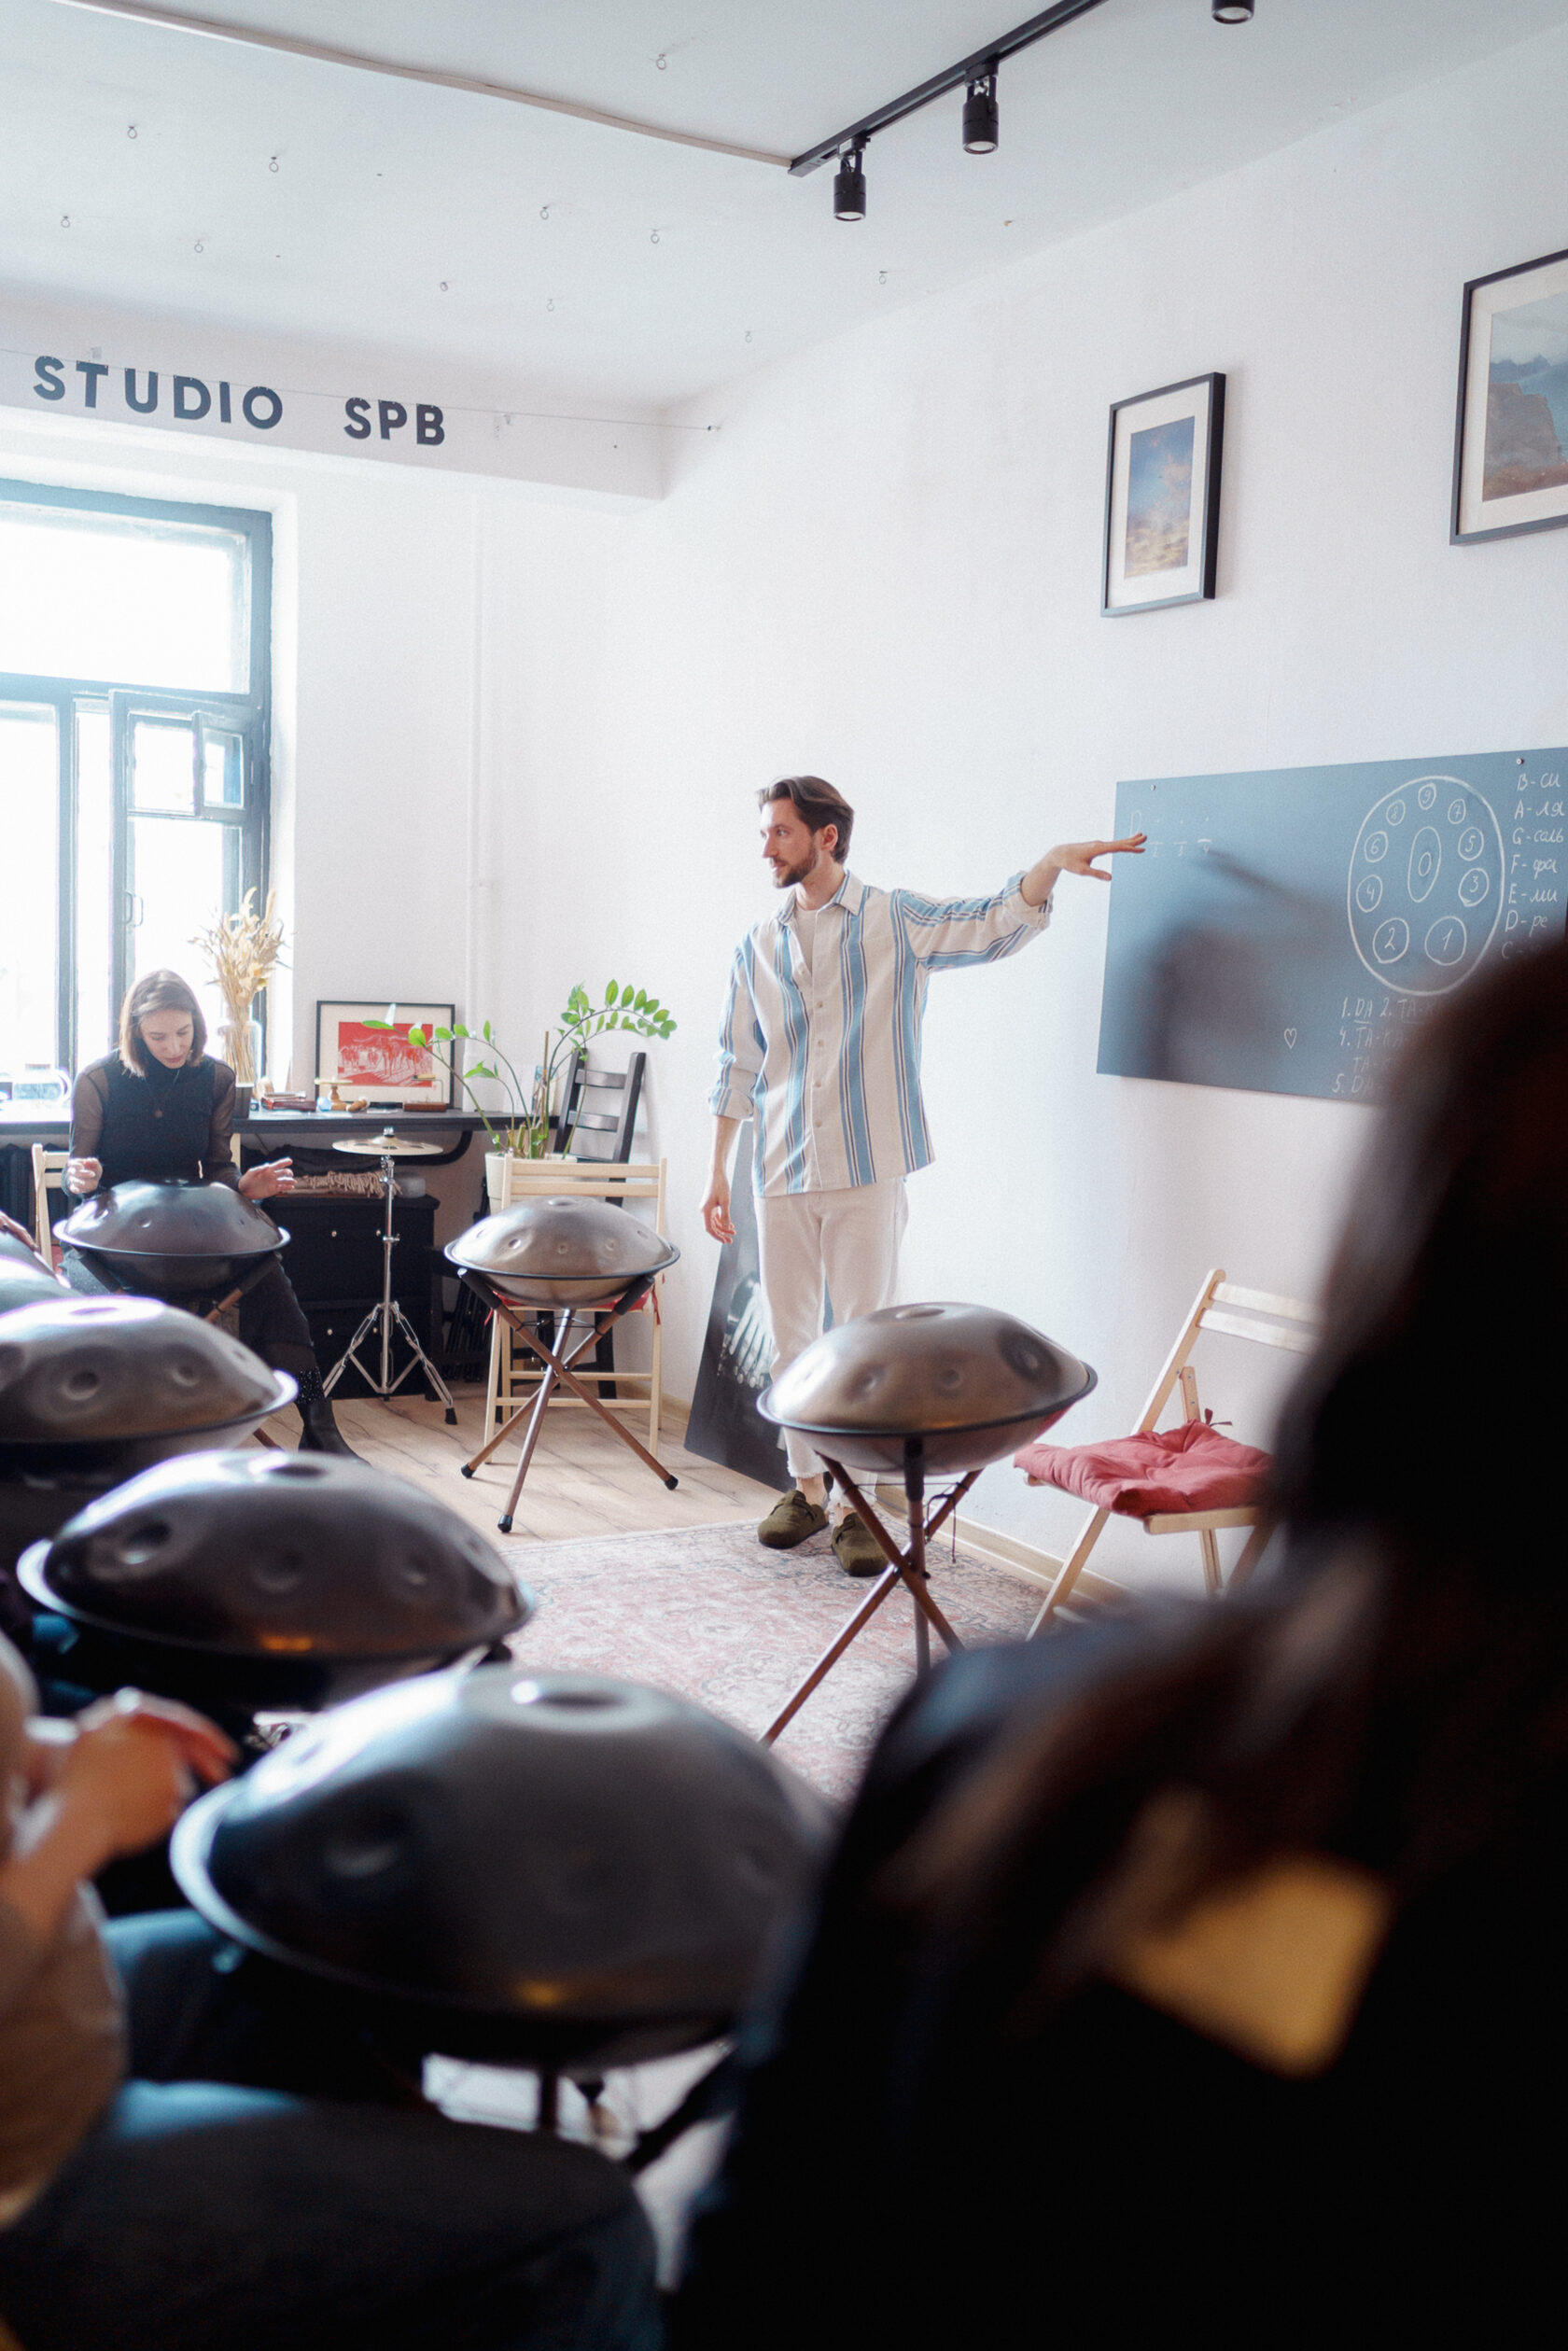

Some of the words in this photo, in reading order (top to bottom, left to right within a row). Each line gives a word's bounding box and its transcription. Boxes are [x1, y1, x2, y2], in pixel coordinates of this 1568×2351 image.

[33, 356, 283, 429] STUDIO
[343, 397, 446, 446] SPB
[1464, 834, 1476, 853] 5
[1365, 883, 1376, 902] 4
[1469, 875, 1479, 893] 3
[1384, 926, 1397, 951] 2
[1443, 928, 1453, 952] 1
[1341, 996, 1351, 1019] 1.
